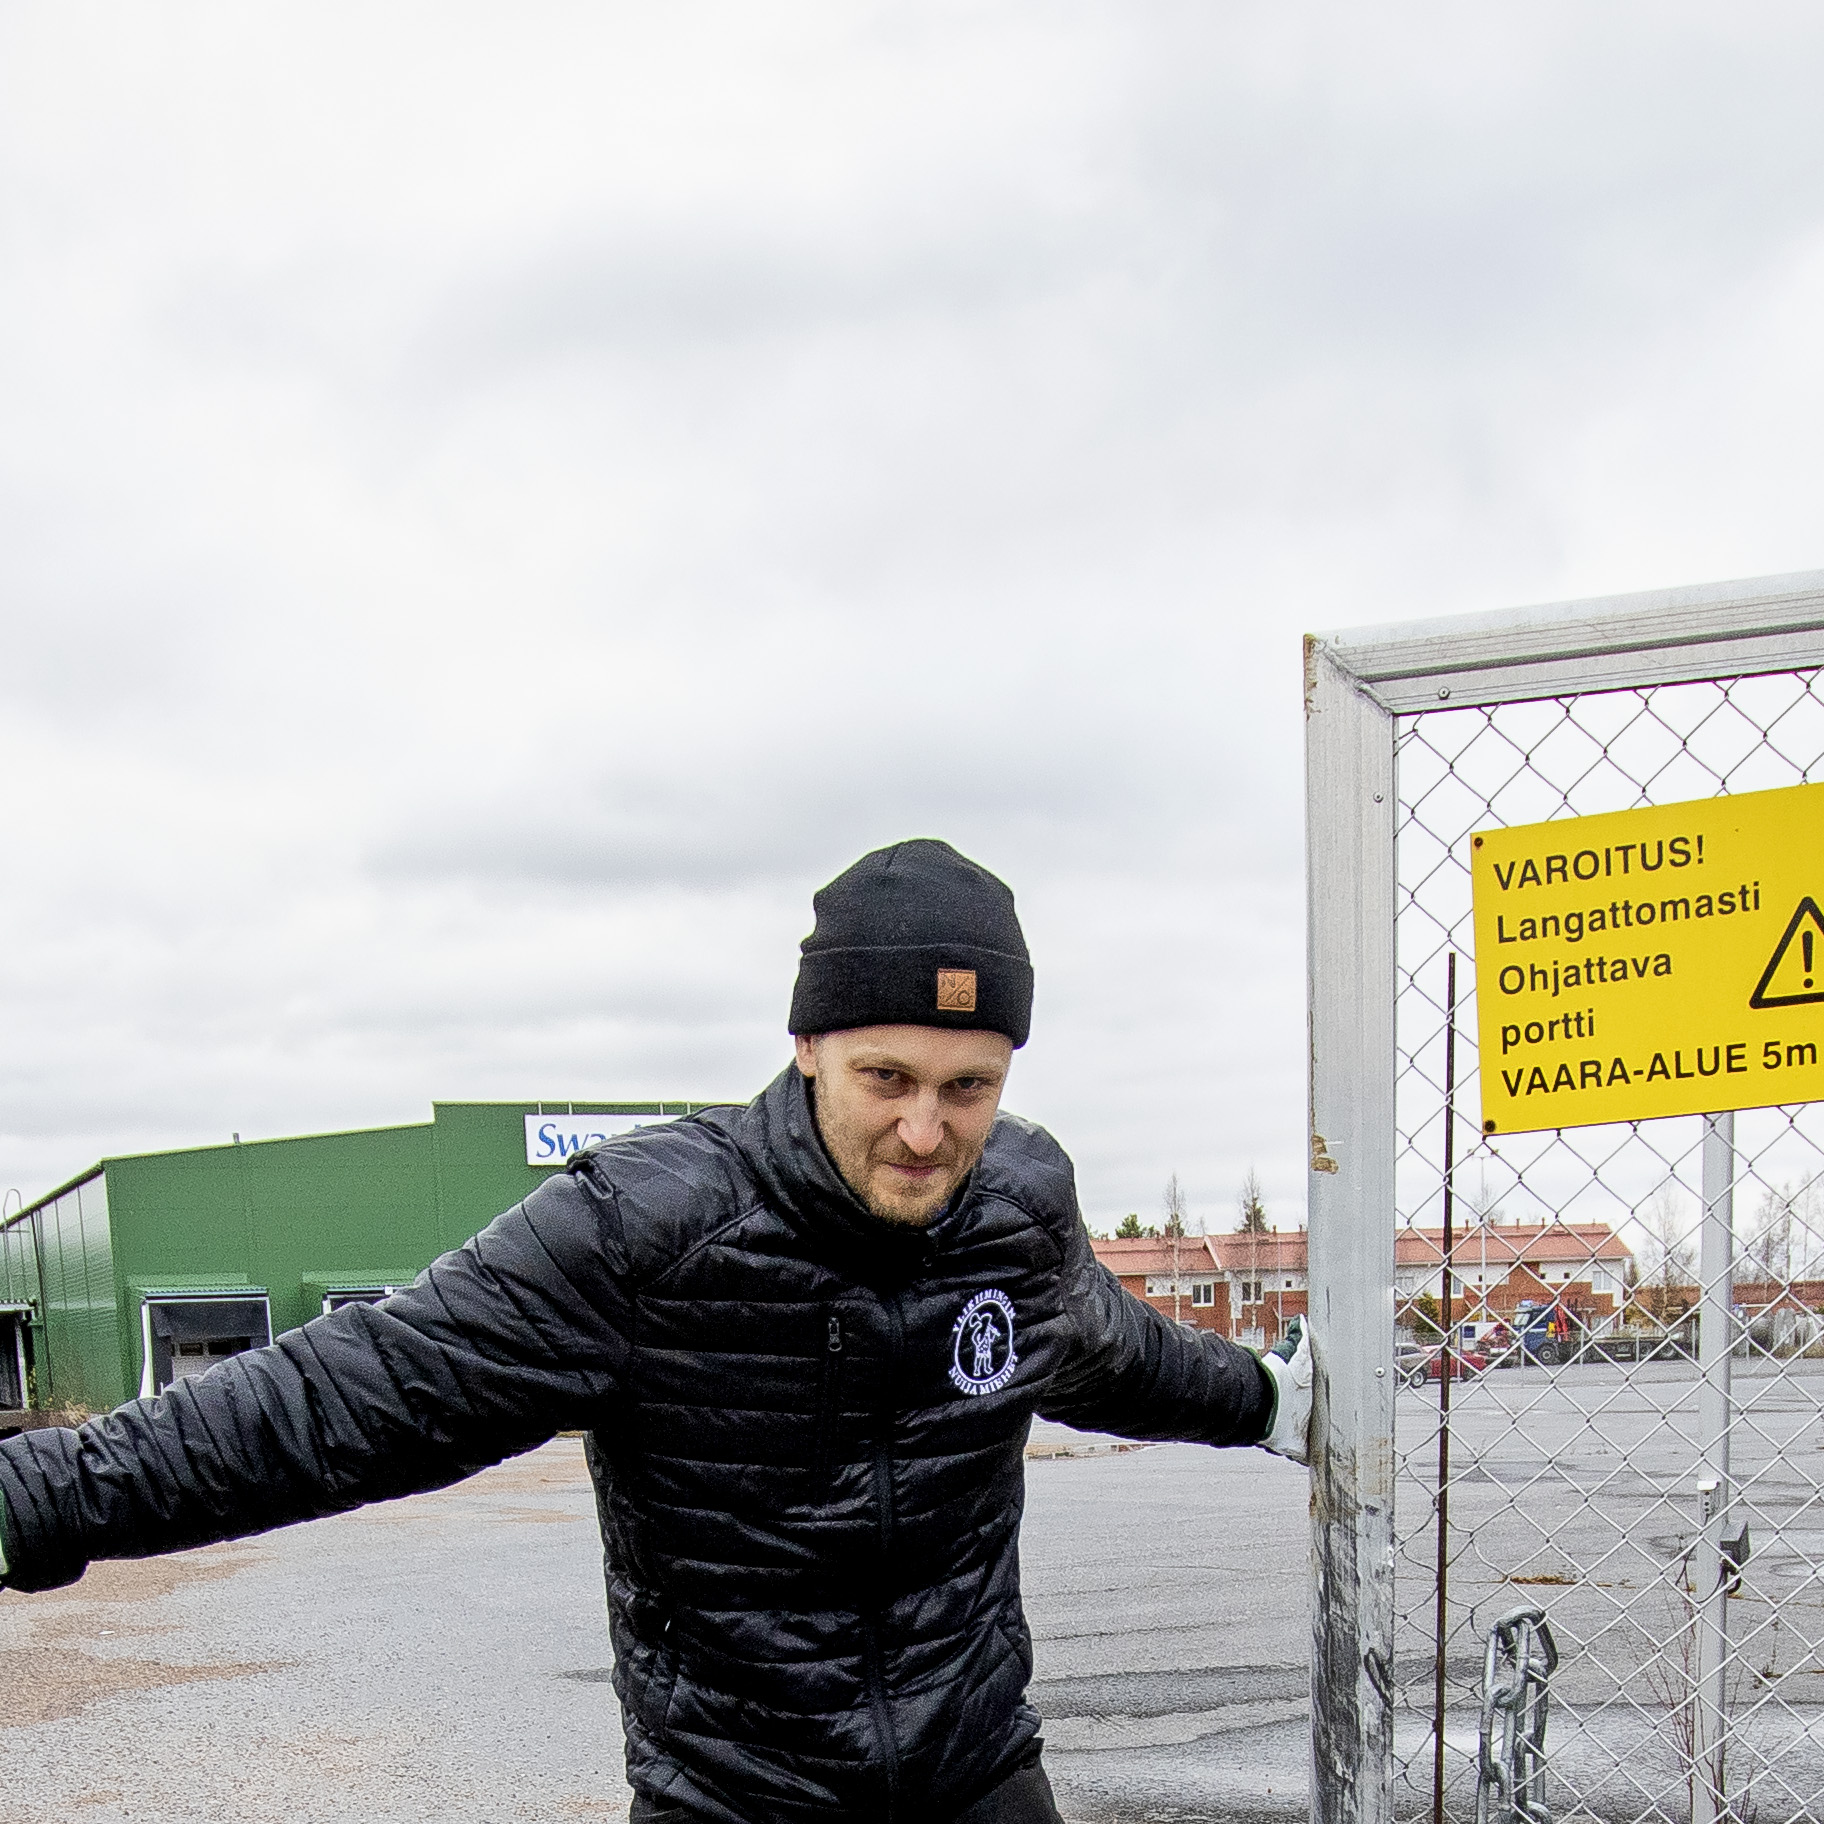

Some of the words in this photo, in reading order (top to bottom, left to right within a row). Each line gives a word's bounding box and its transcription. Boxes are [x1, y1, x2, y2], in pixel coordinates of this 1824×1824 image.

[1493, 834, 1706, 892] VAROITUS!
[1496, 883, 1761, 944] Langattomasti
[1498, 952, 1673, 997] Ohjattava
[1500, 1009, 1595, 1055] portti
[1501, 1042, 1749, 1098] VAARA-ALUE
[1761, 1040, 1818, 1071] 5m
